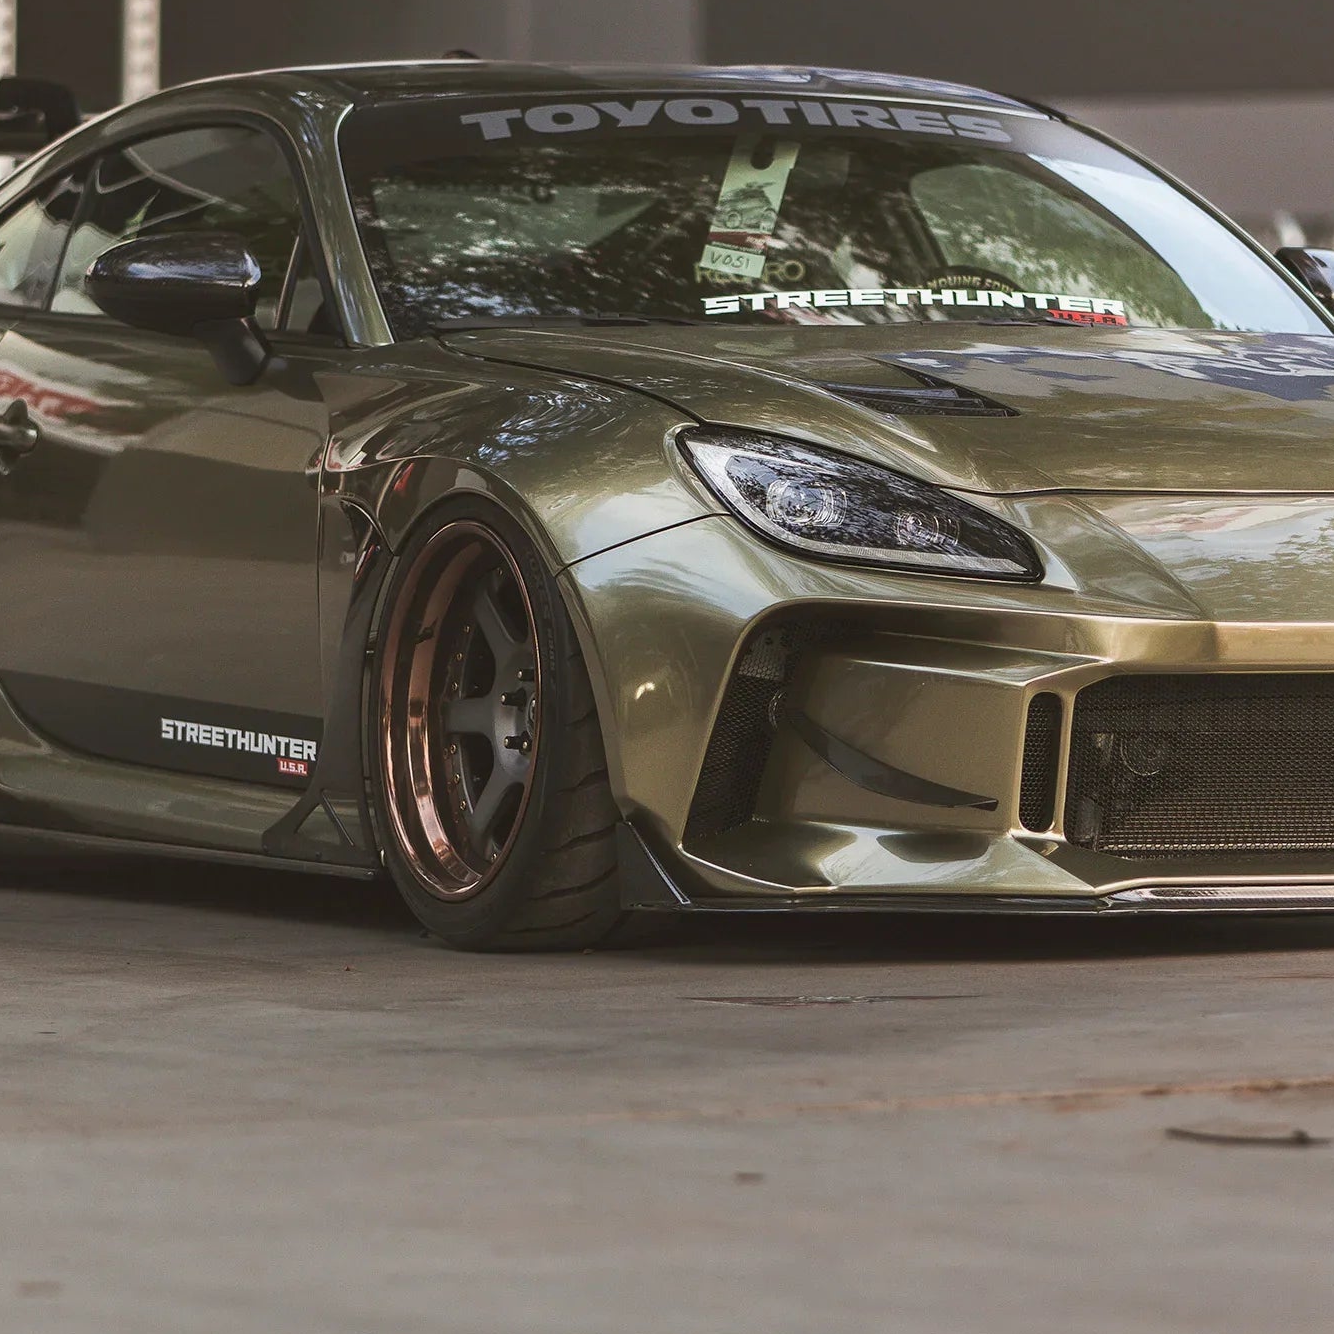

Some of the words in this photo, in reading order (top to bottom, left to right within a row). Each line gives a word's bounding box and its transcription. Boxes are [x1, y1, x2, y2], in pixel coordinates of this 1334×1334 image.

[460, 99, 739, 140] TOYO
[741, 99, 1012, 143] TIRES
[700, 288, 1126, 315] STREETHUNTER
[161, 718, 317, 761] STREETHUNTER
